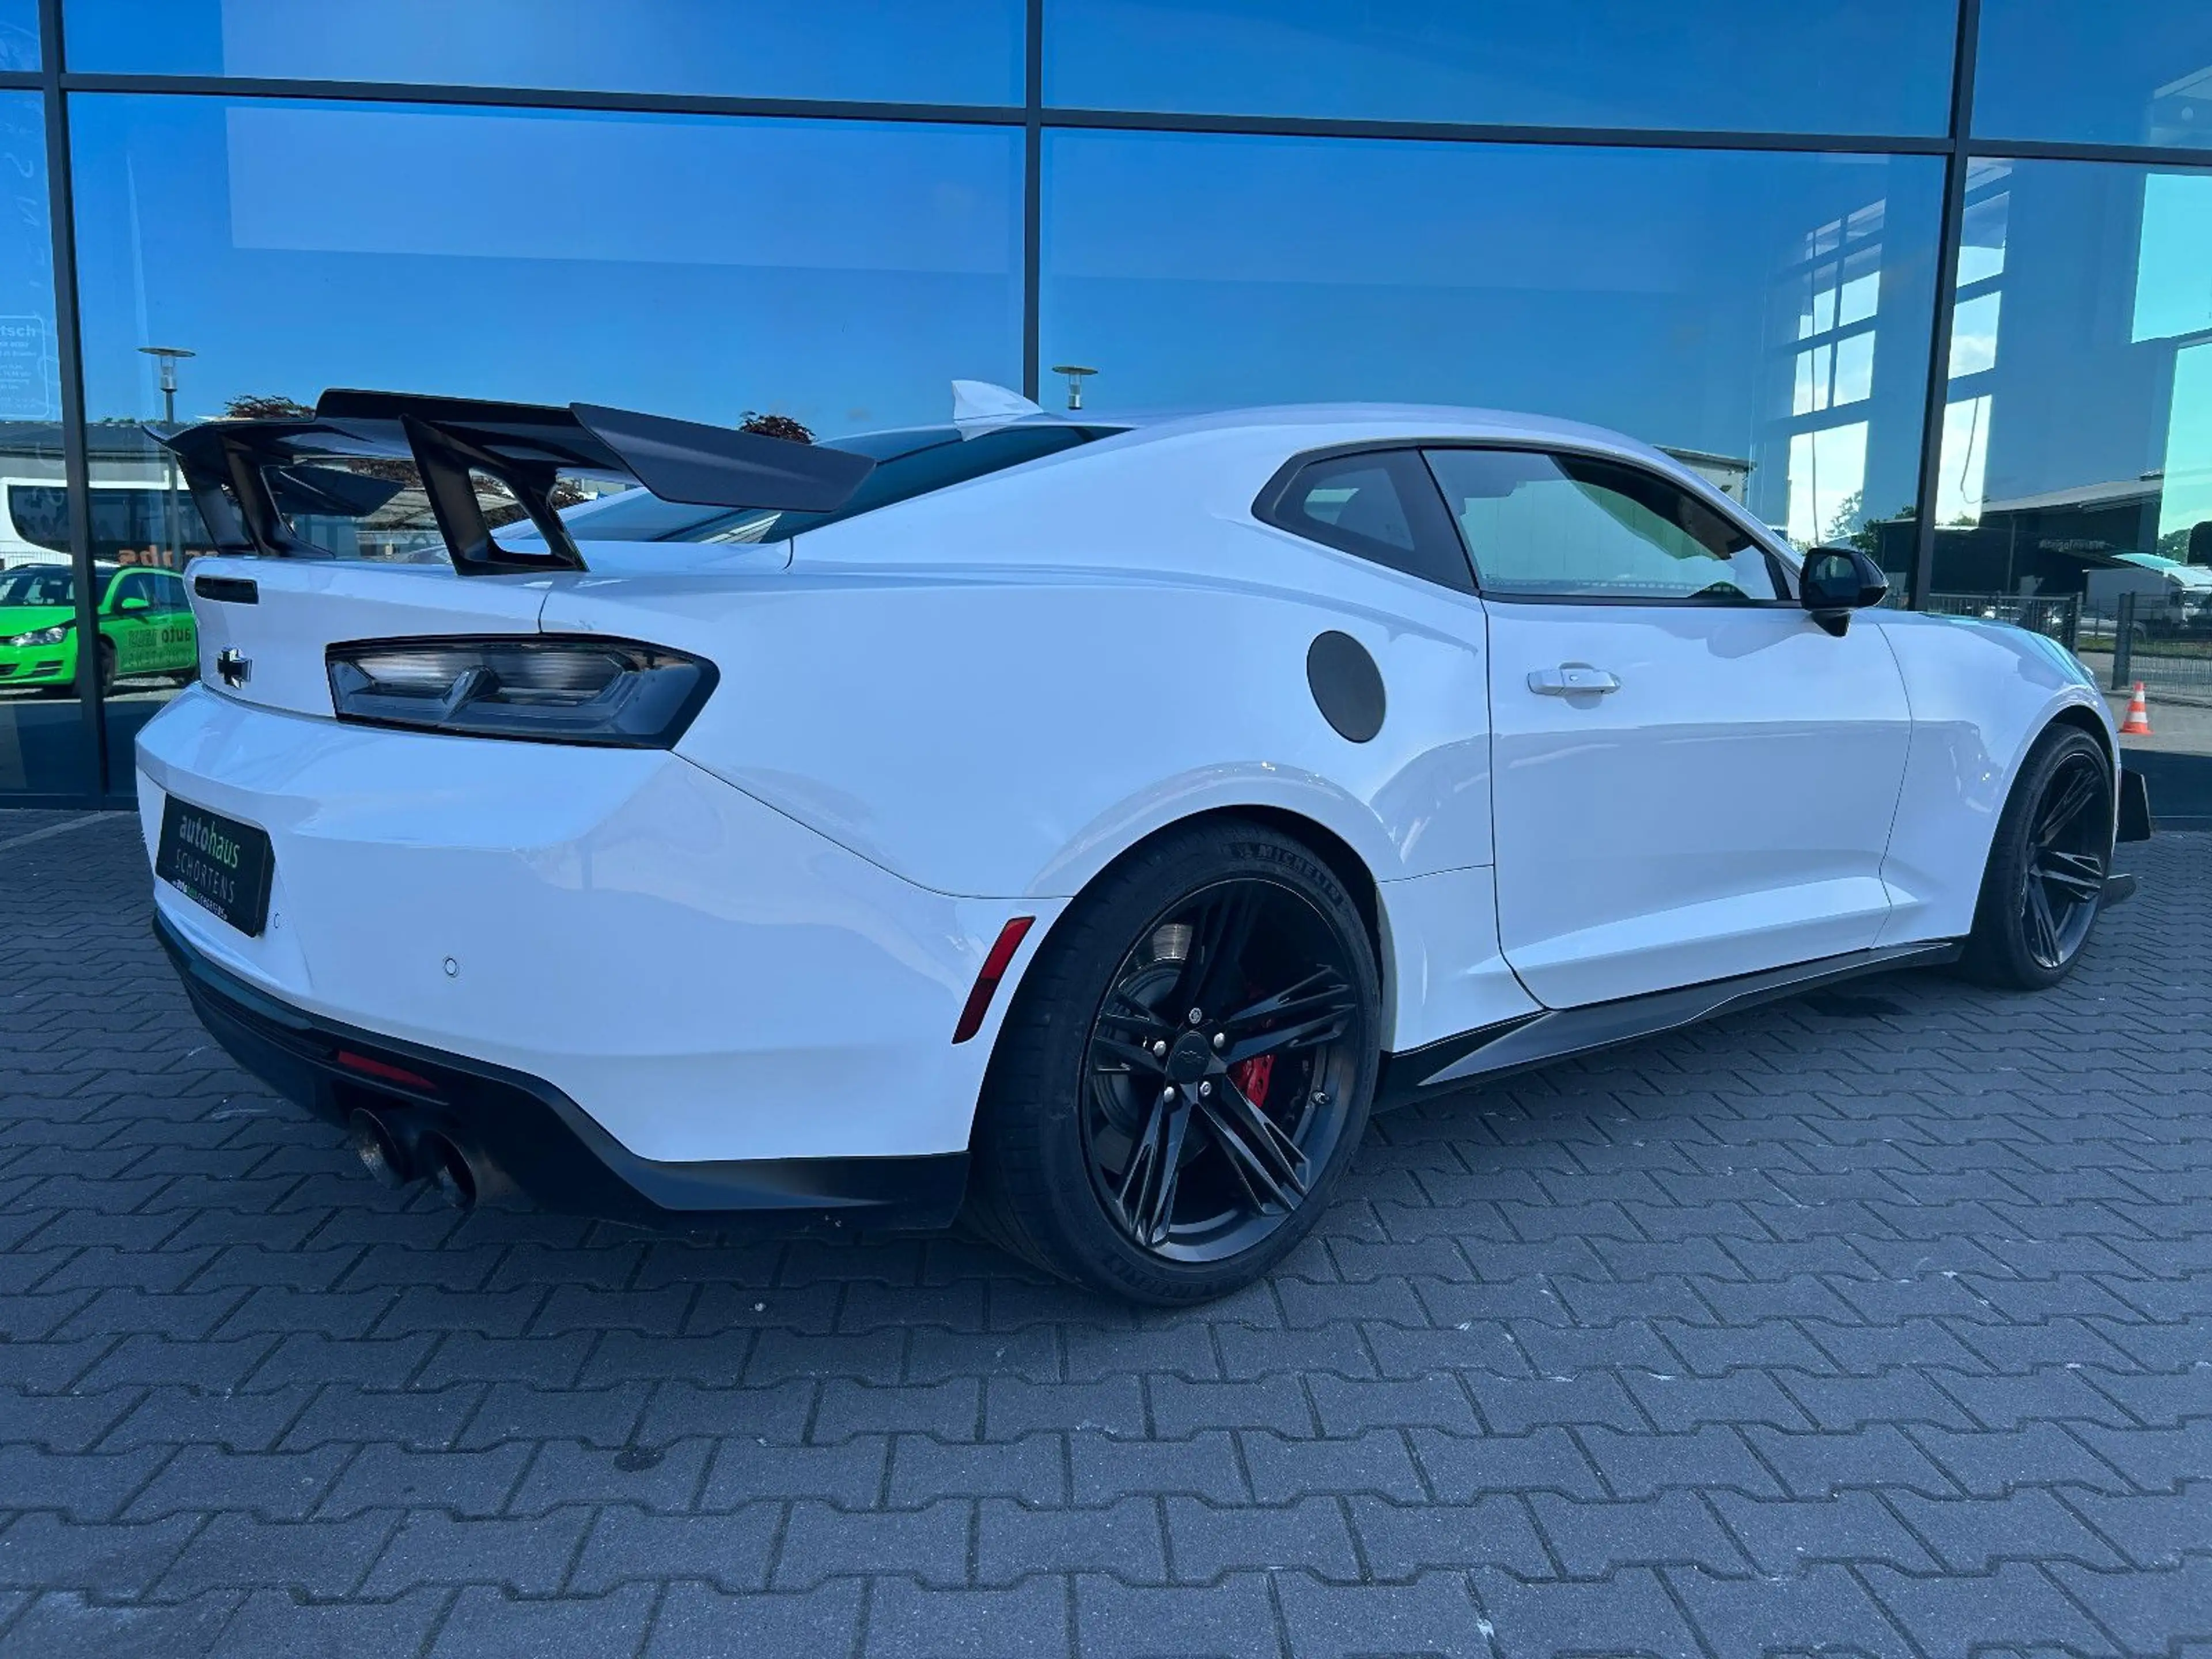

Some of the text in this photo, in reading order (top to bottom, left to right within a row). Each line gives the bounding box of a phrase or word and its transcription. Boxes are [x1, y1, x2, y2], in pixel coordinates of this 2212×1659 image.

[180, 815, 240, 868] autohaus
[175, 849, 235, 903] SCHORTENS
[1259, 844, 1342, 902] MICHELIN
